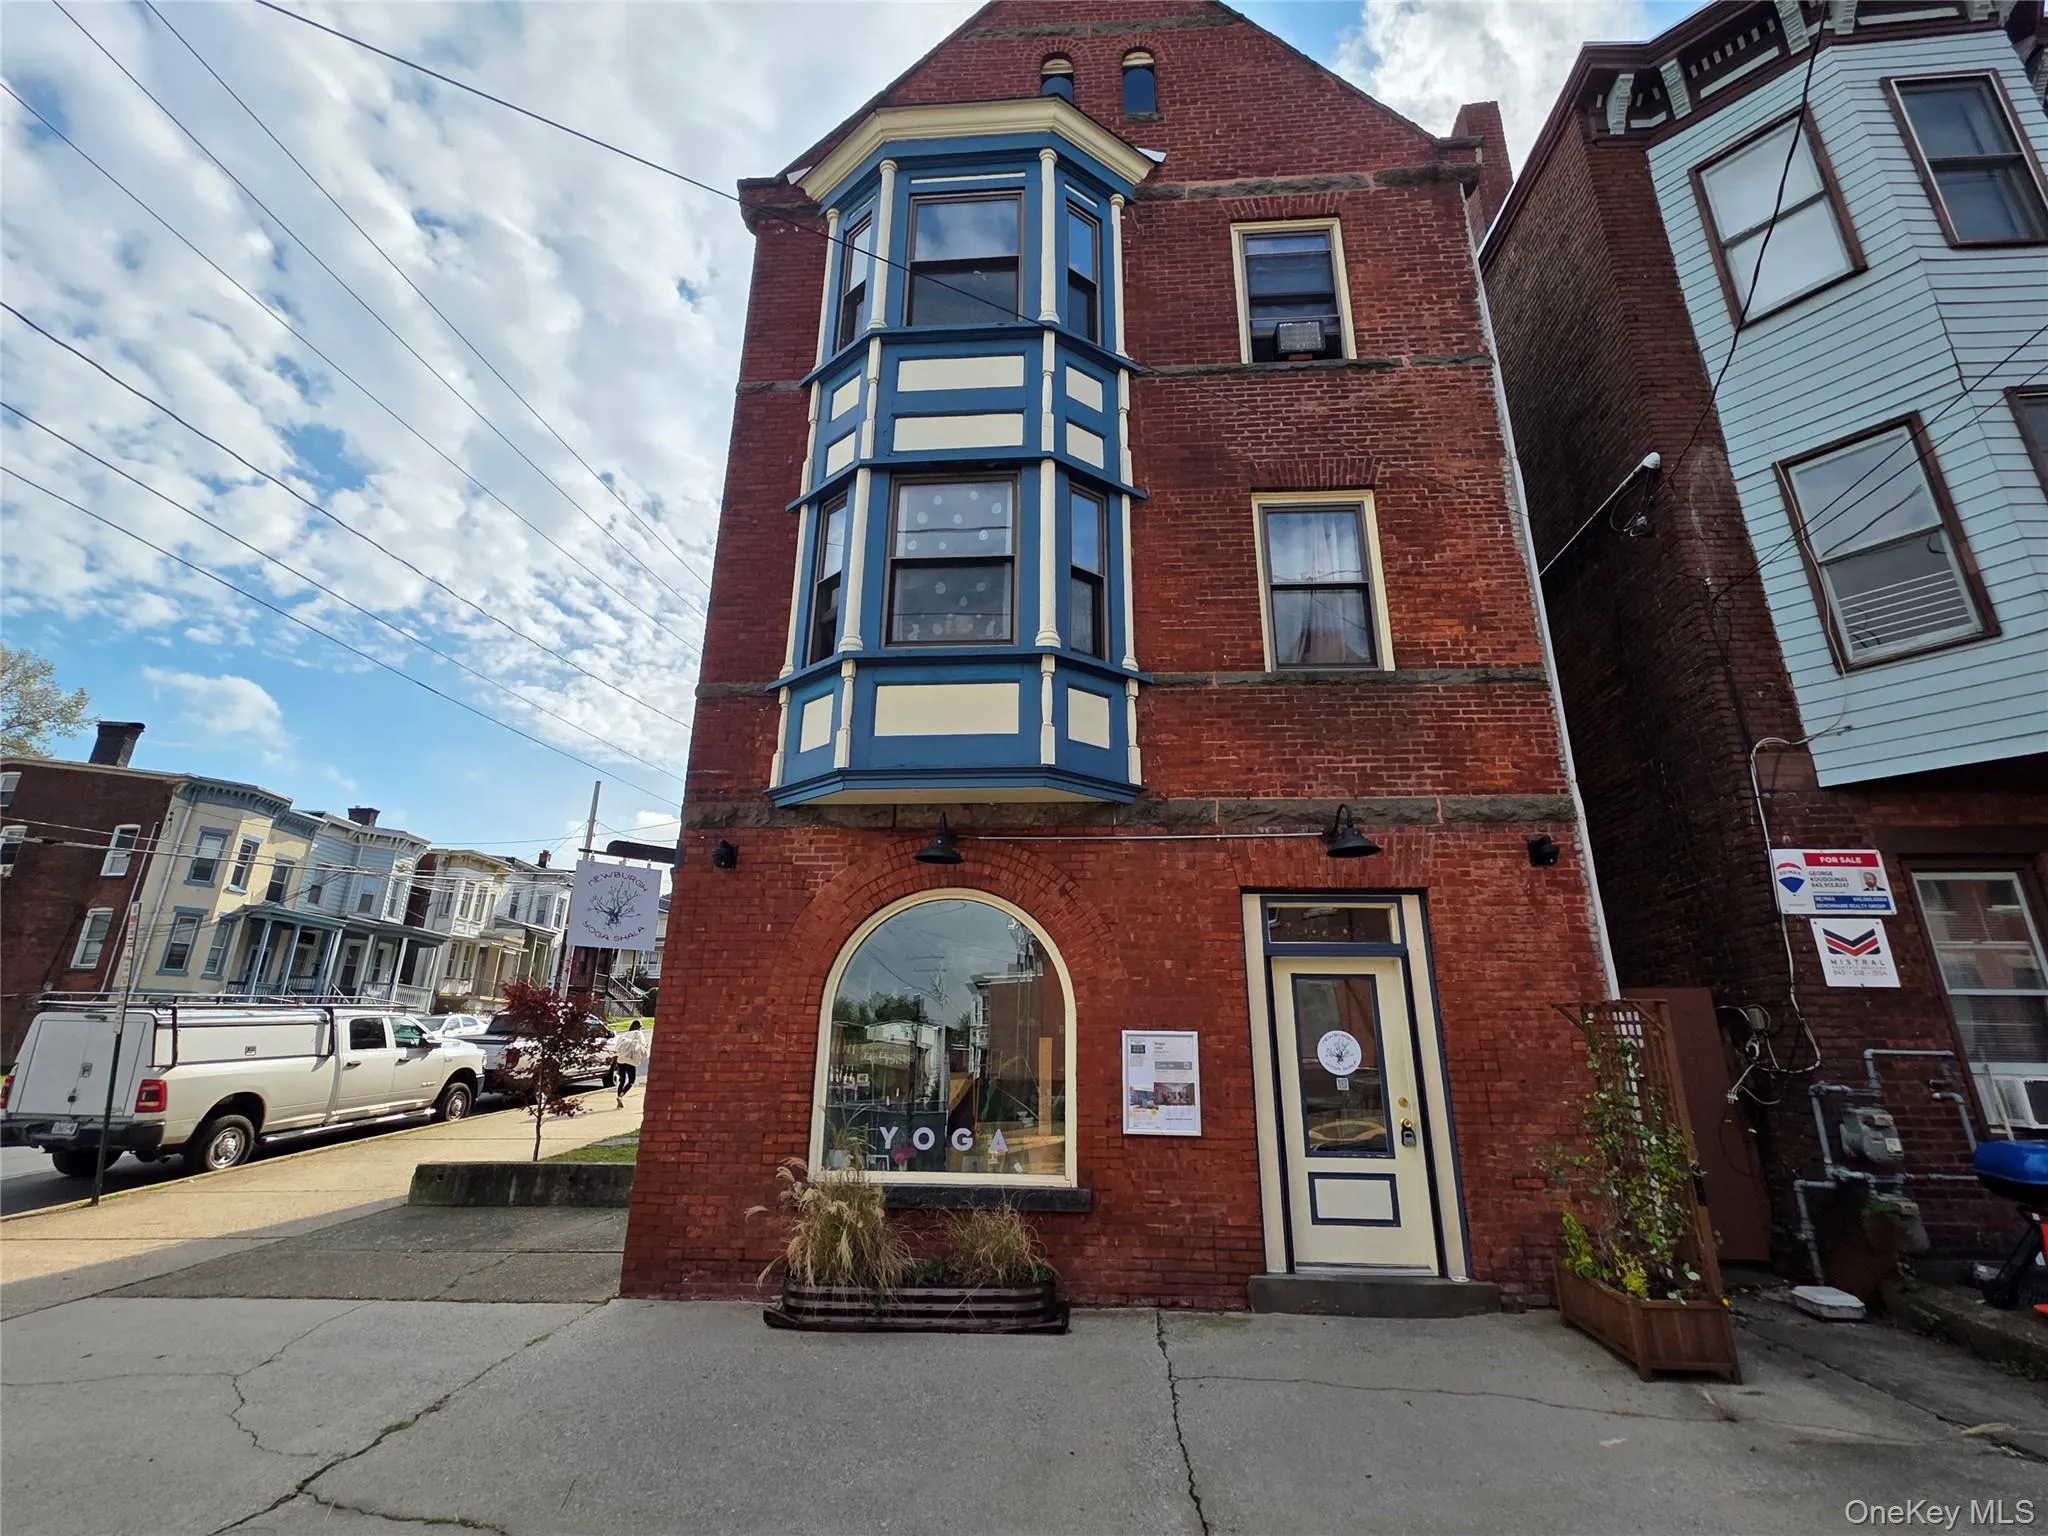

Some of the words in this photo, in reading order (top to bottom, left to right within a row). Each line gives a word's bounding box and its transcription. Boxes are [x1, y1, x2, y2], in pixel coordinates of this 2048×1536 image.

[1819, 856, 1839, 864] FOR
[1839, 856, 1863, 864] SALE
[588, 871, 648, 892] NEWBURGH
[582, 920, 610, 941] YOGA
[613, 926, 645, 942] SHALA
[879, 1126, 1009, 1152] YOGA
